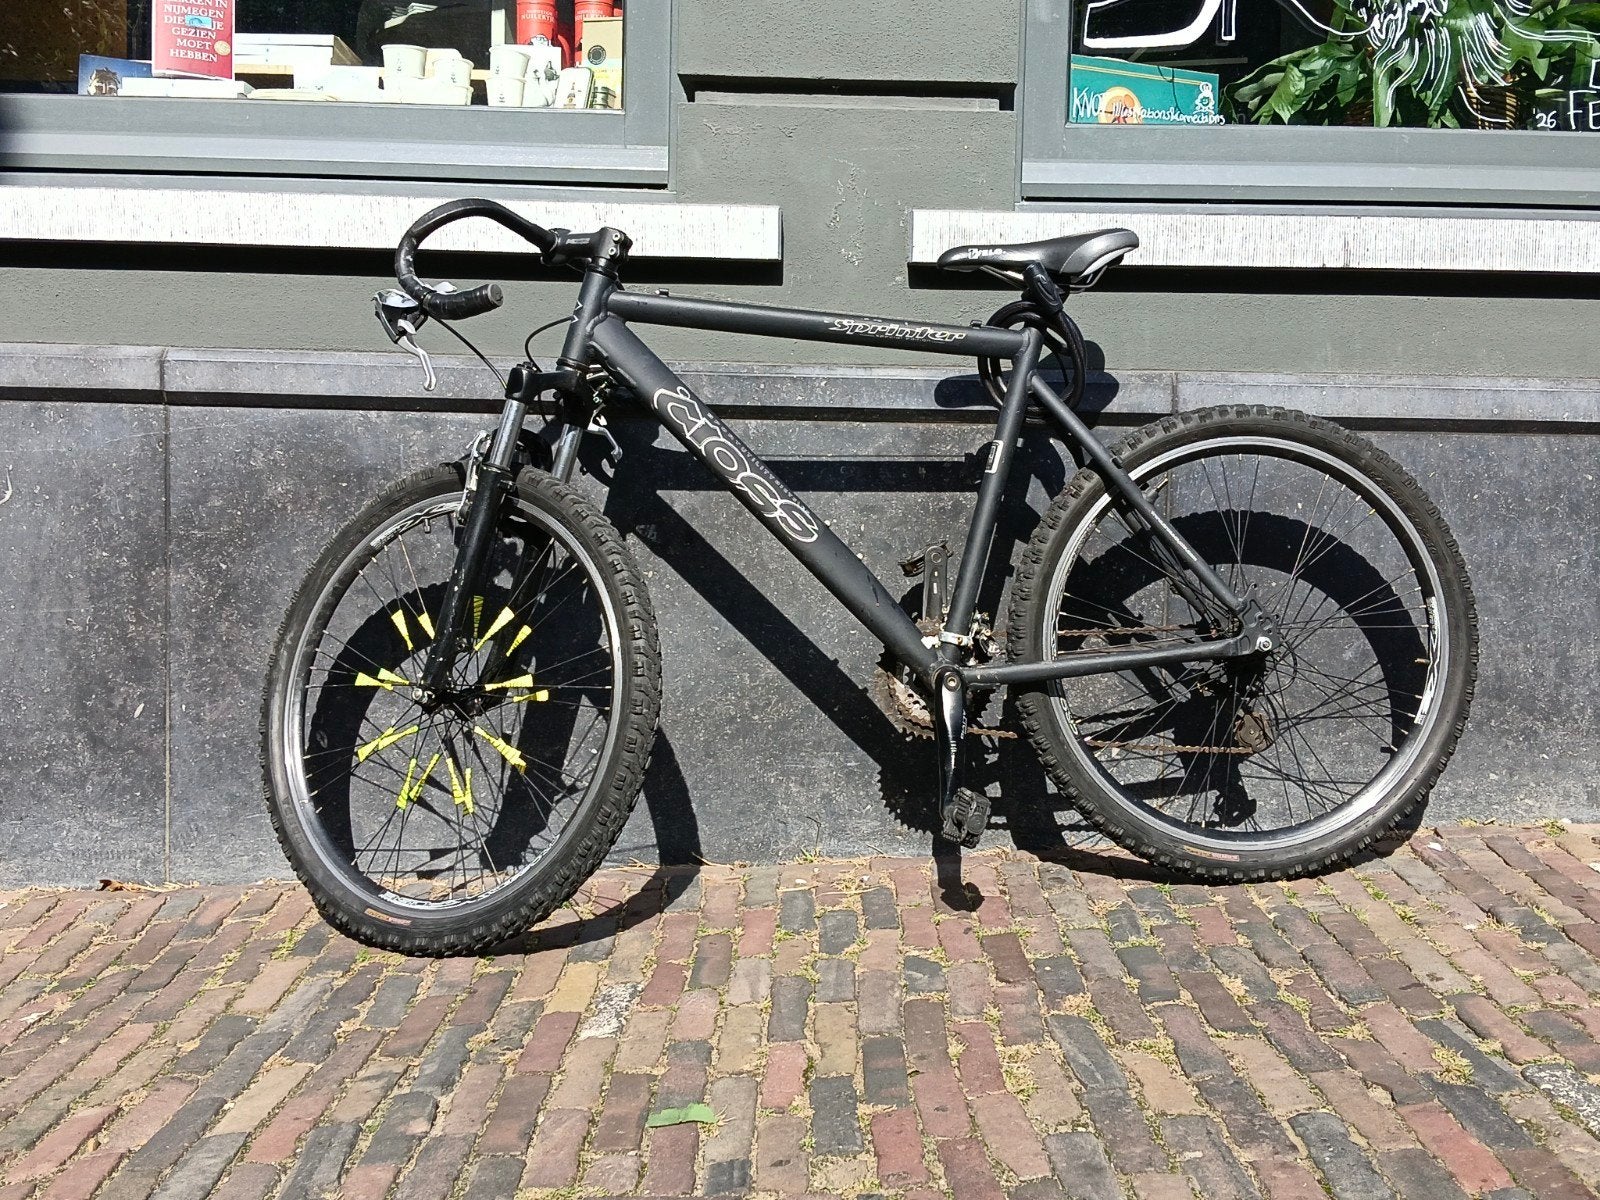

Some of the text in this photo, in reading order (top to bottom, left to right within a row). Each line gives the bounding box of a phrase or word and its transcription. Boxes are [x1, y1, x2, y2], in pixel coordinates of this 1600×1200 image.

[215, 0, 228, 9] IN
[163, 4, 224, 19] NIJMEGEN
[164, 15, 224, 30] DIE JE
[171, 27, 216, 40] GEZIEN
[176, 38, 212, 50] MOET
[169, 49, 218, 62] HEBBEN
[1532, 107, 1557, 129] '26
